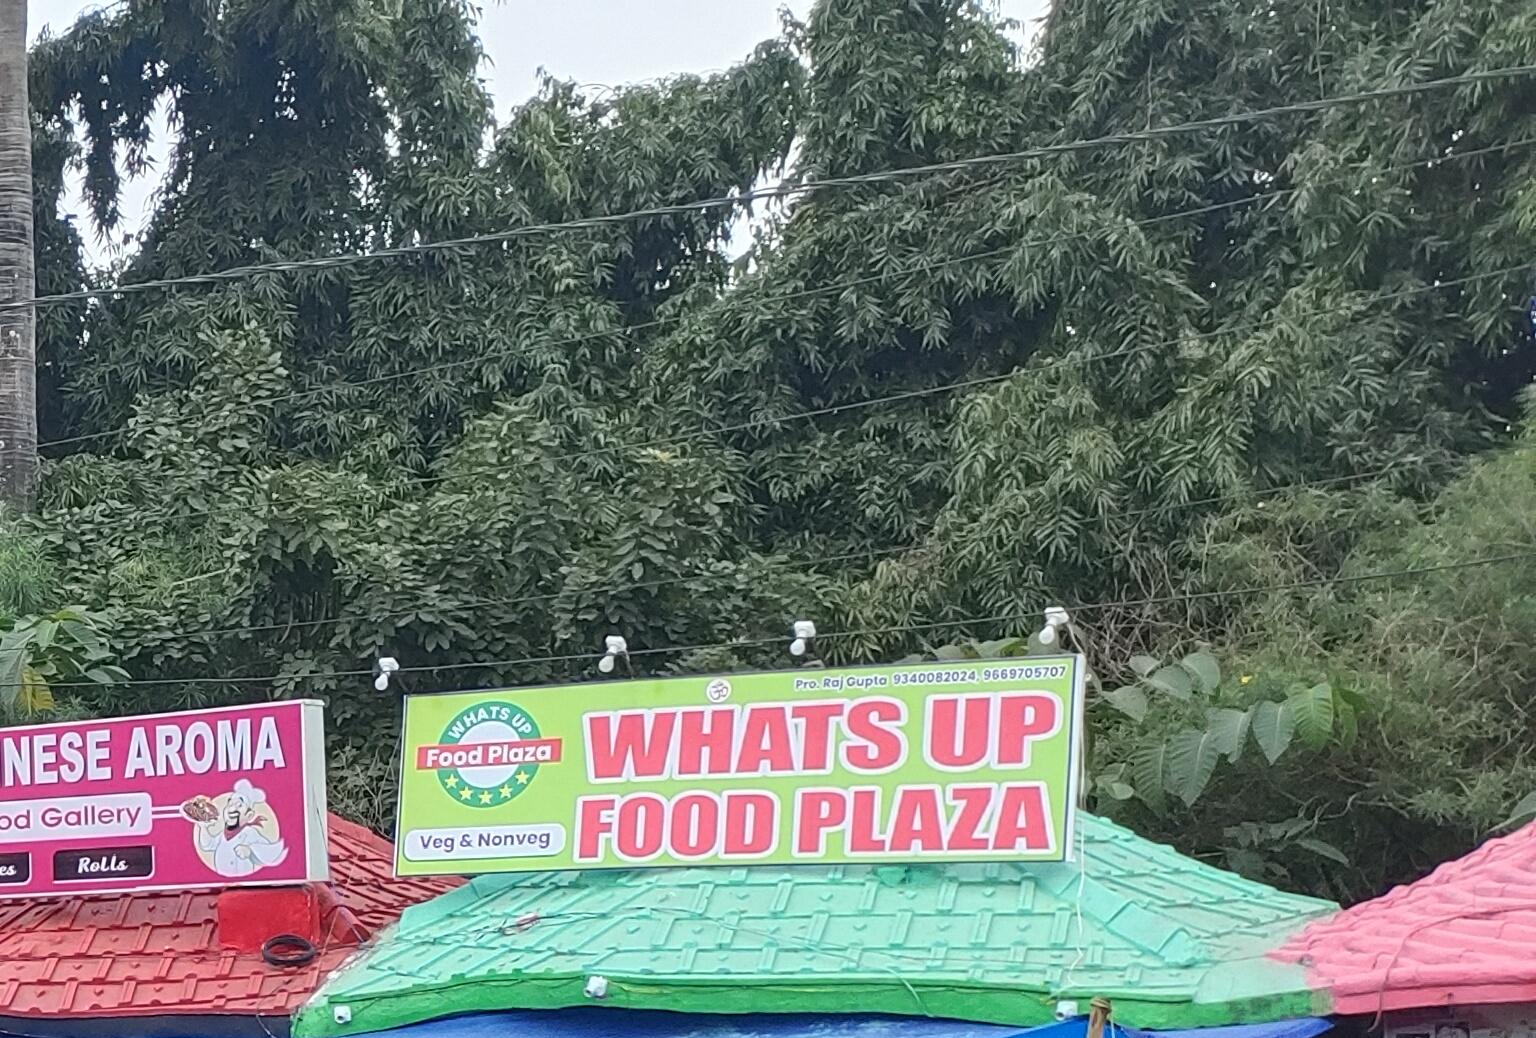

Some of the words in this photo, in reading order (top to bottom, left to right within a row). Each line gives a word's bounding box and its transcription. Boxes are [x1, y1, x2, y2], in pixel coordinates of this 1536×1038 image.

[796, 679, 819, 690] Pro.
[823, 677, 843, 691] Raj
[847, 674, 887, 690] Gupta
[448, 706, 510, 740] WHATS
[512, 713, 532, 735] UP
[589, 700, 902, 779] WHATS
[930, 696, 1057, 769] UP
[124, 716, 286, 779] AROMA
[426, 746, 482, 768] Food
[488, 744, 552, 764] Plaza
[40, 802, 142, 832] Gallery
[579, 792, 773, 858] FOOD
[799, 784, 1050, 854] PLAZA
[420, 835, 454, 853] Veg
[460, 834, 473, 847] &
[478, 832, 551, 849] Nonveg
[78, 854, 128, 874] Rolls
